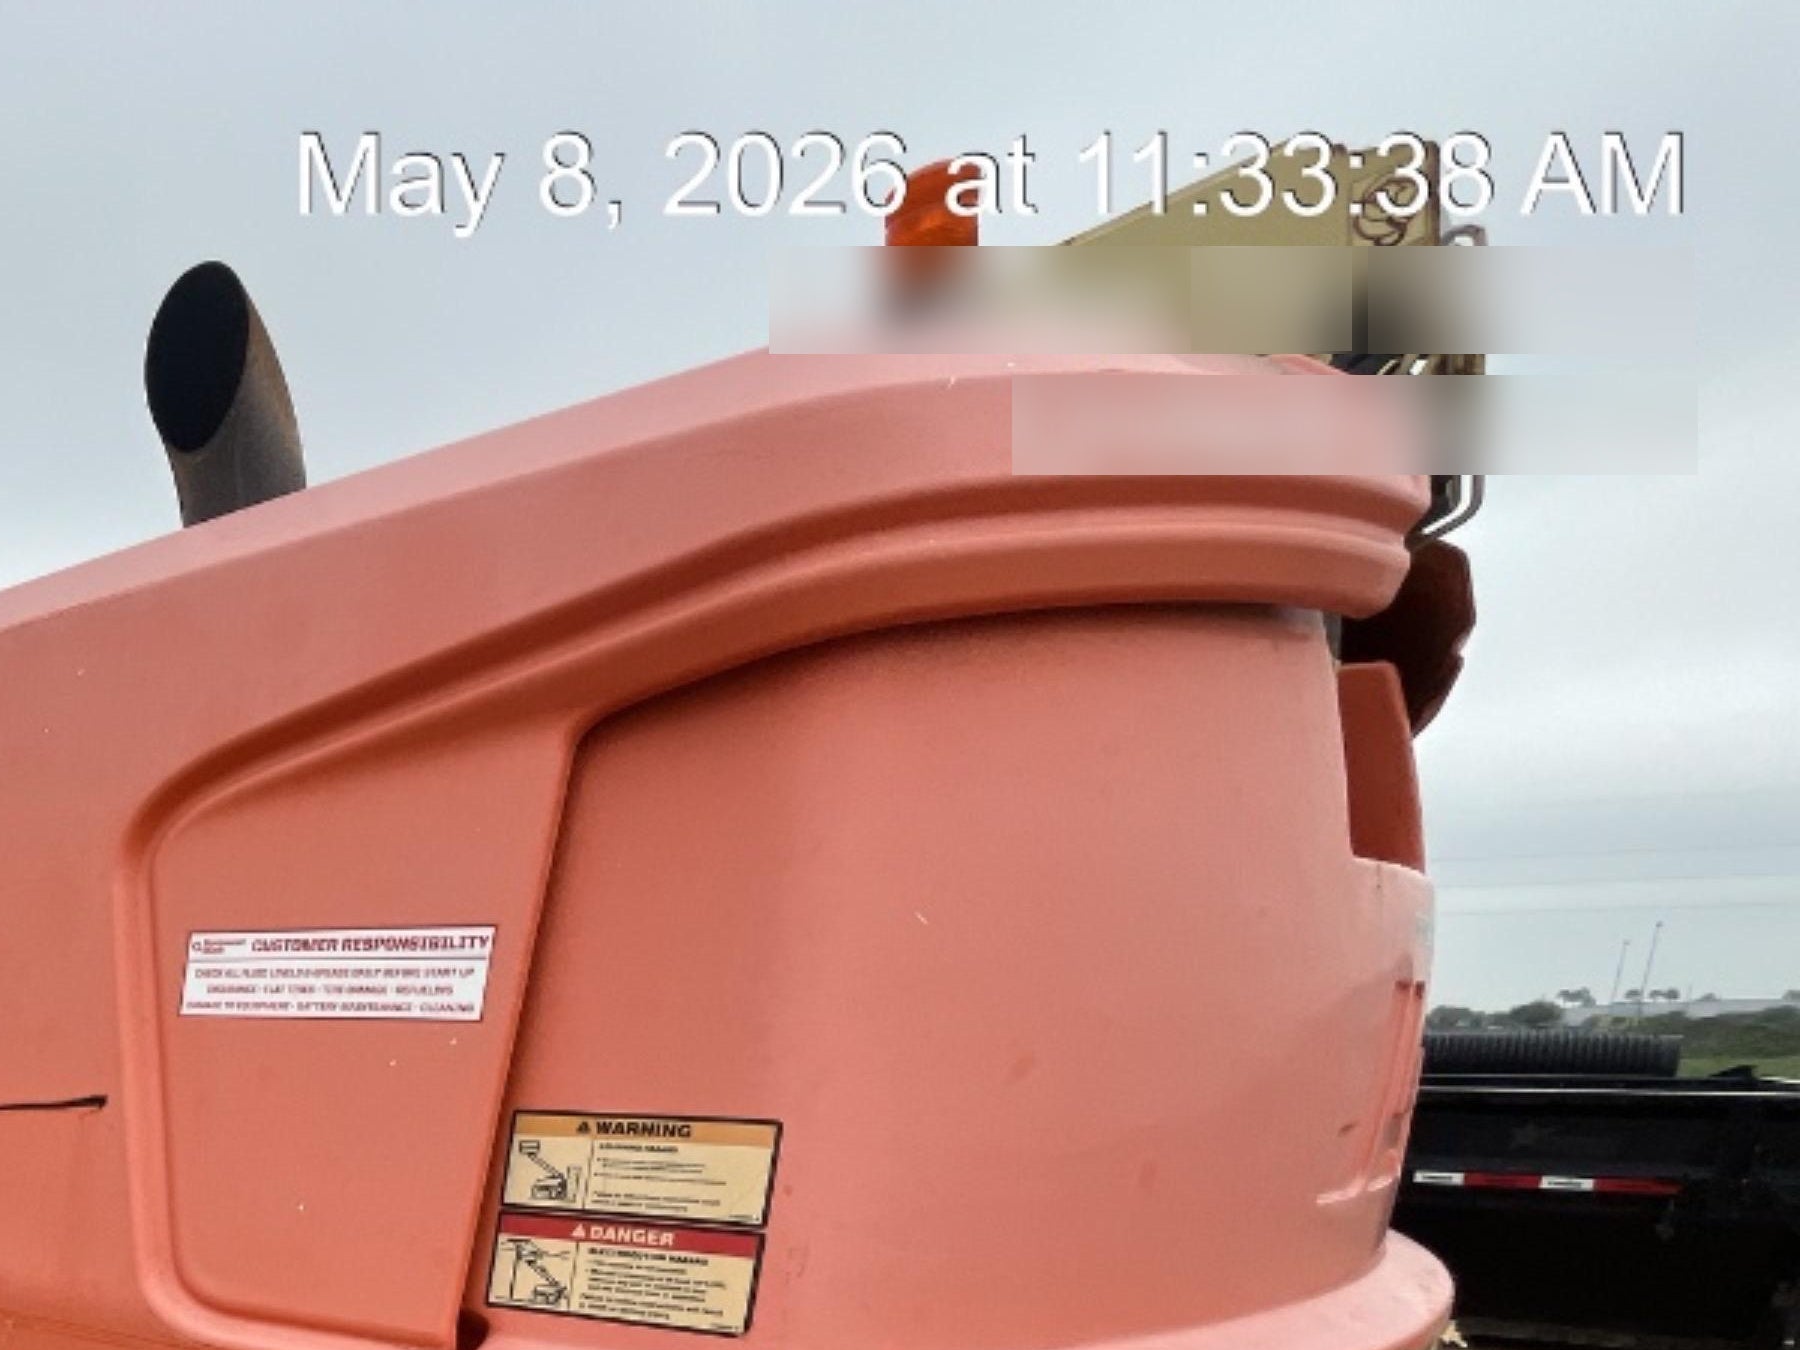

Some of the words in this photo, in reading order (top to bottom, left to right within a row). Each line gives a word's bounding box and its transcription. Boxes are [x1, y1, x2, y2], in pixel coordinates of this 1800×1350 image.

[251, 938, 338, 952] CUSTOMER
[341, 935, 490, 952] RESPONSIBILITY
[595, 1120, 692, 1139] WARNING
[589, 1225, 675, 1247] DANGER
